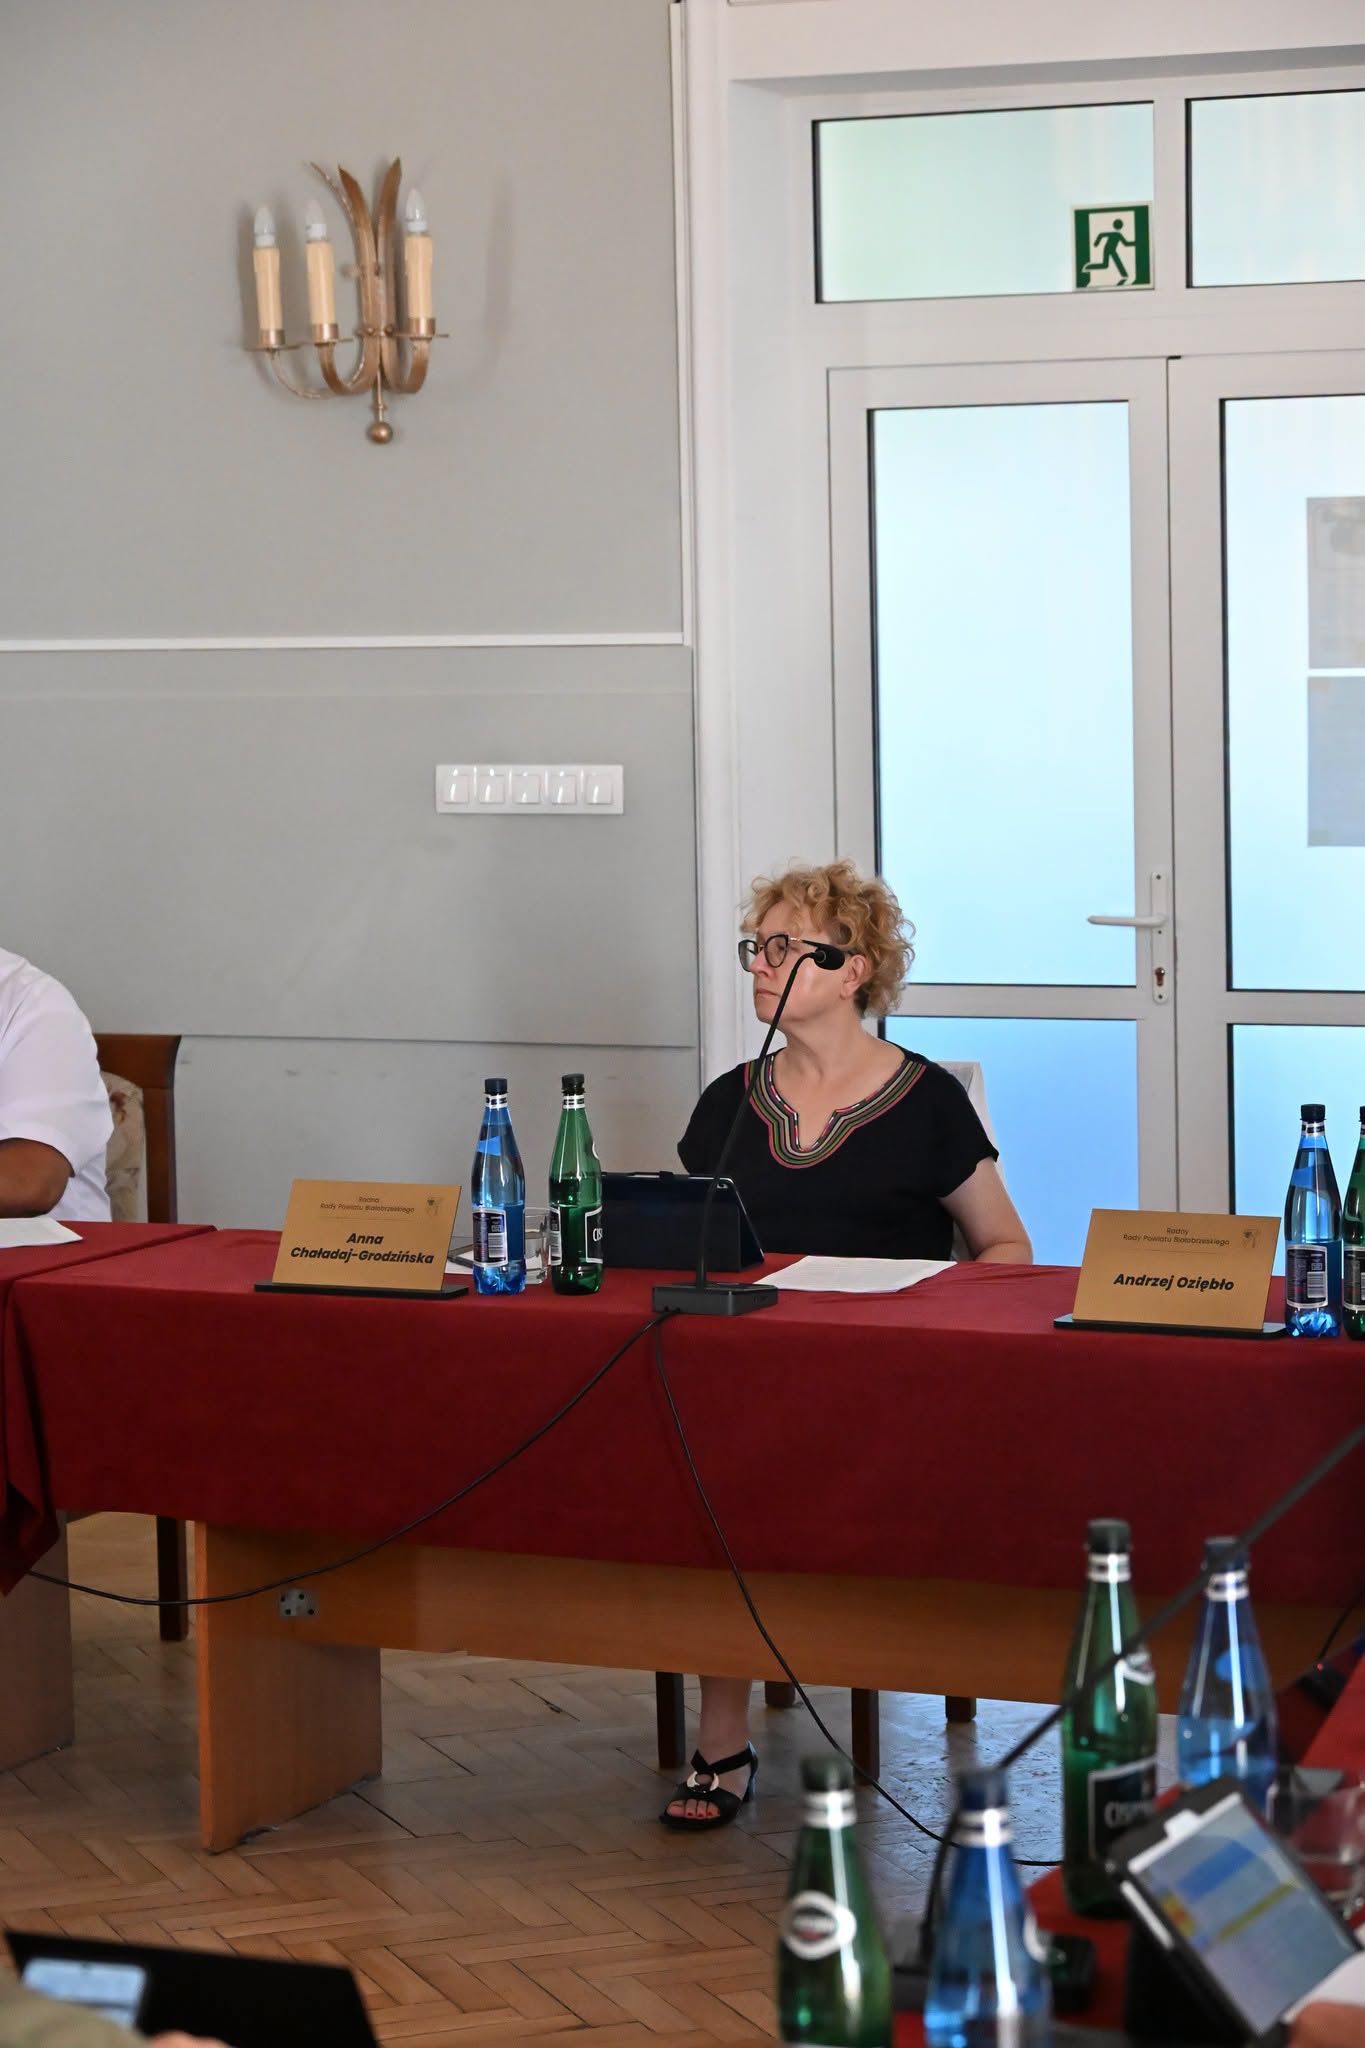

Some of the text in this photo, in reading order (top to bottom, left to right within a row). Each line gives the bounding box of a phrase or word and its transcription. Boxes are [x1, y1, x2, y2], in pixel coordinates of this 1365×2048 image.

[1166, 1227, 1189, 1235] Radny
[346, 1233, 384, 1245] Anna
[1123, 1234, 1141, 1242] Rady
[290, 1247, 435, 1264] Chaładaj-Grodzińska
[1113, 1273, 1235, 1292] Andrzej Oziębło
